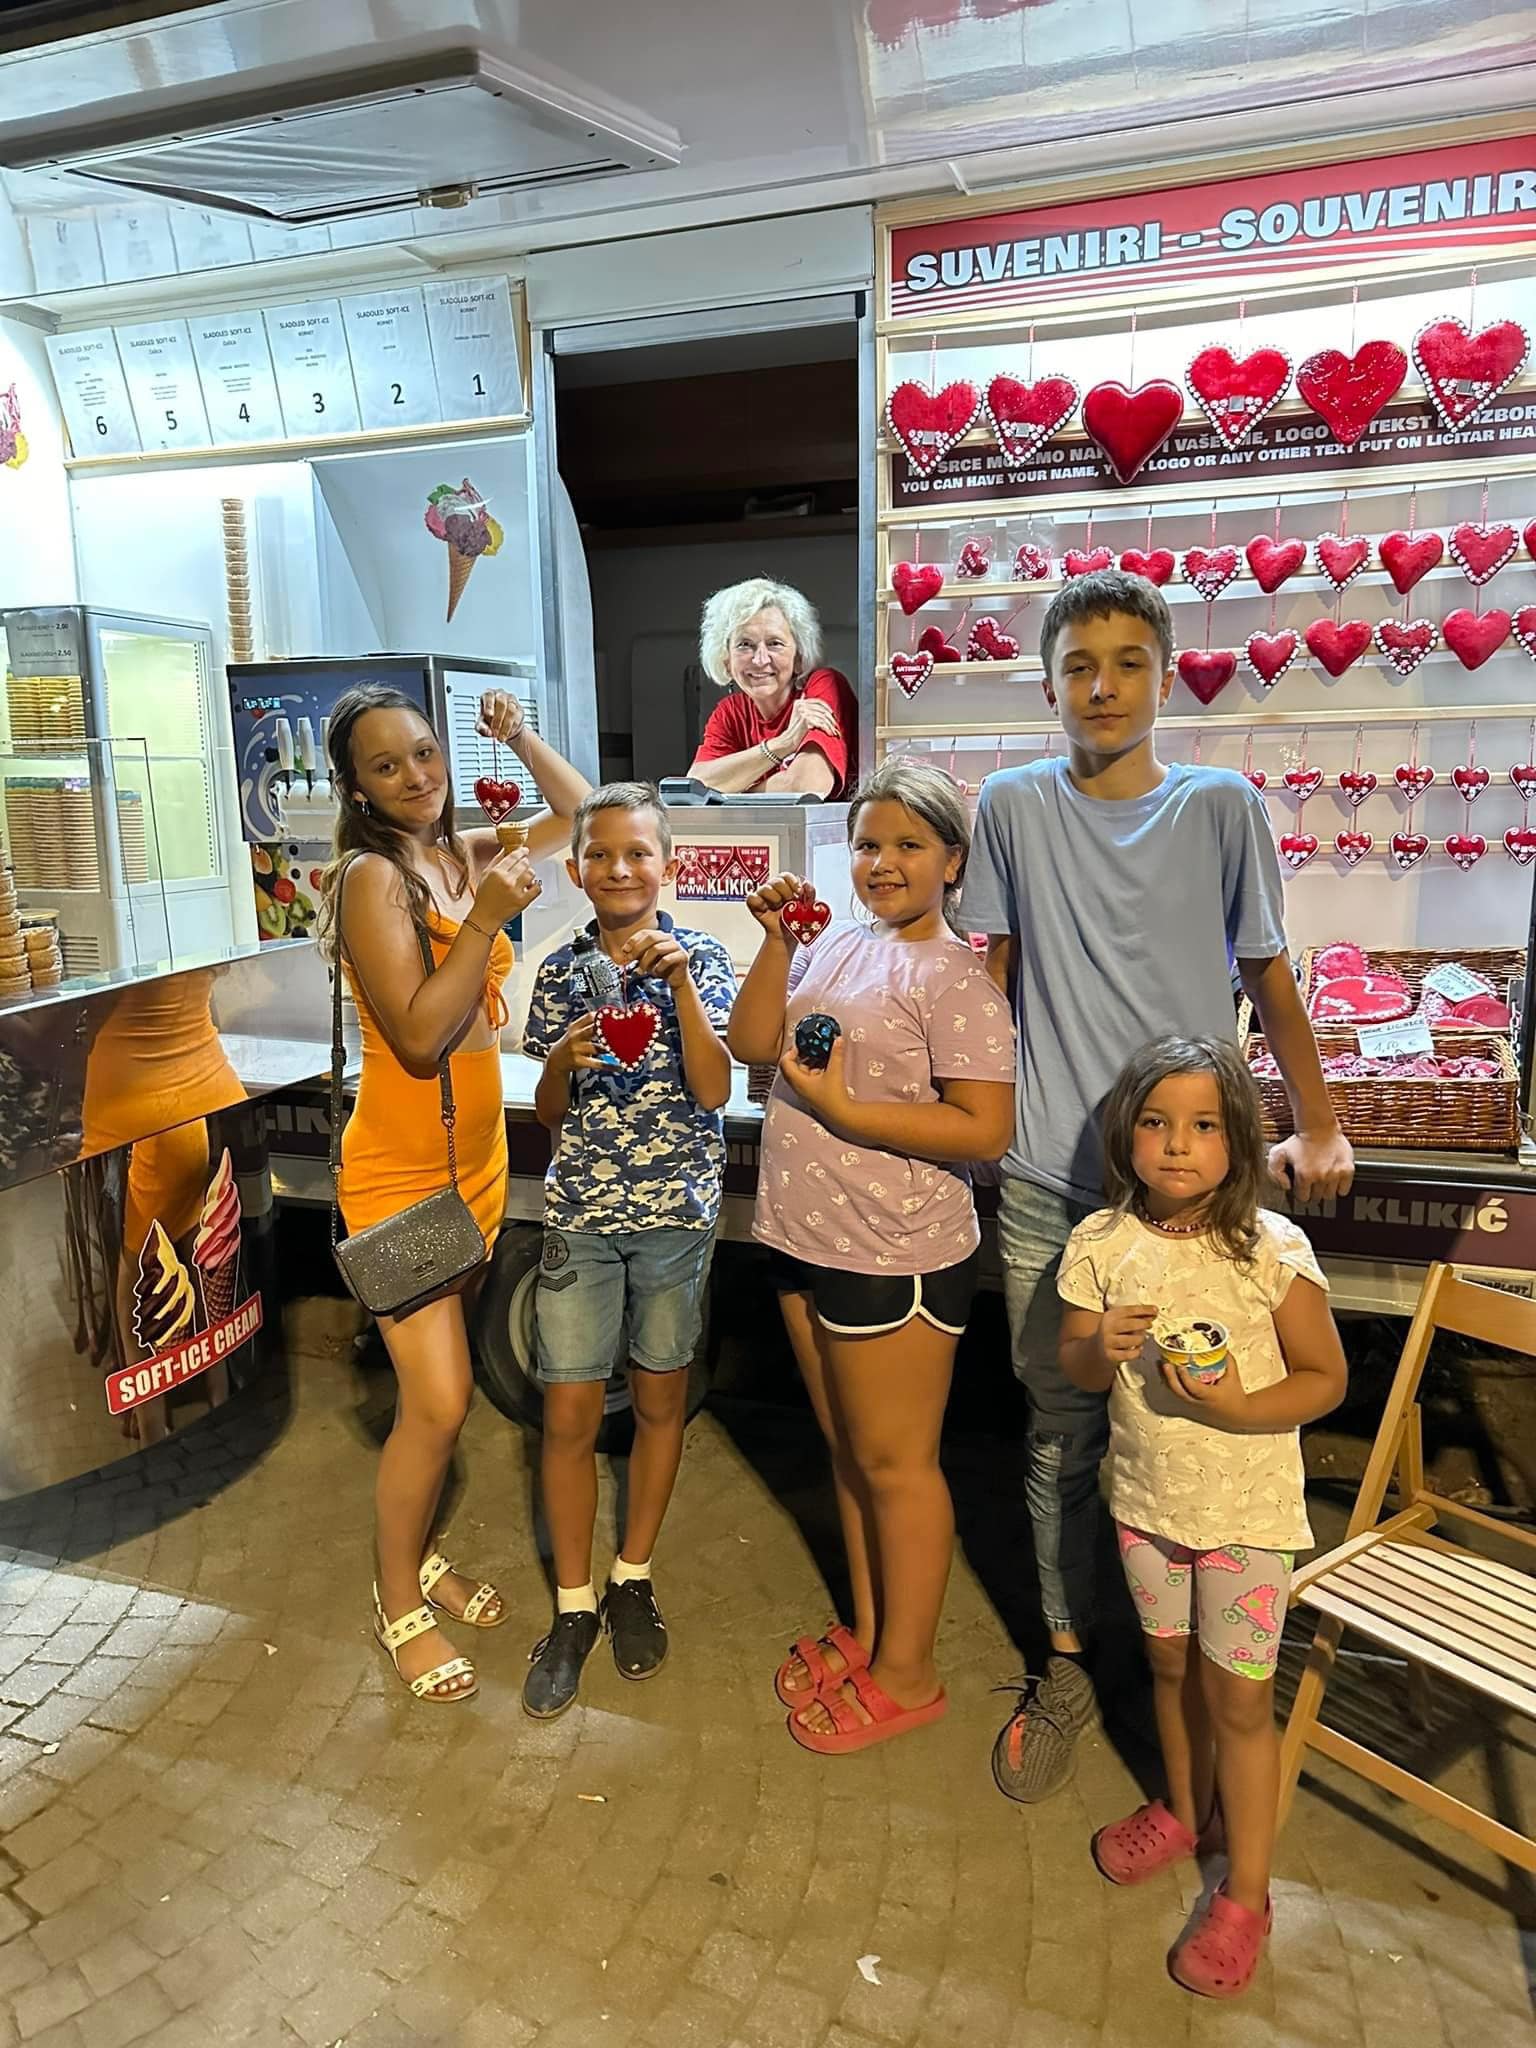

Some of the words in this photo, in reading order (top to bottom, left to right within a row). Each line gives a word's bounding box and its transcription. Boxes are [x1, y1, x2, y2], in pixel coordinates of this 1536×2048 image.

[905, 221, 1162, 292] SUVENIRI
[1180, 232, 1203, 248] -
[1220, 169, 1536, 251] SOUVENIR
[391, 383, 405, 405] 2
[473, 374, 486, 396] 1
[239, 403, 250, 423] 4
[312, 392, 325, 414] 3
[96, 415, 108, 436] 6
[165, 410, 178, 431] 5
[937, 456, 982, 474] SRCE
[986, 449, 1065, 470] MOEMO
[1174, 433, 1220, 452] VAŠE
[1274, 424, 1330, 443] LOGO
[1368, 415, 1432, 434] TEKST
[901, 480, 930, 493] YOU
[933, 476, 963, 490] CAN
[967, 473, 1004, 488] HAVE
[1007, 469, 1048, 484] YOUR
[1050, 465, 1100, 481] NAME,
[1148, 456, 1191, 472] LOGO
[1194, 454, 1217, 467] OR
[1220, 451, 1255, 465] ANY
[1258, 446, 1311, 462] OTHER
[1314, 443, 1354, 457] TEXT
[1359, 438, 1393, 453] PUT
[1396, 435, 1422, 450] ON
[1426, 429, 1495, 447] LICITAR
[1499, 425, 1536, 441] HEA
[1353, 1196, 1509, 1233] KLIKIĆ
[118, 1338, 212, 1404] SOFT-ICE
[213, 1302, 260, 1355] CREAM
